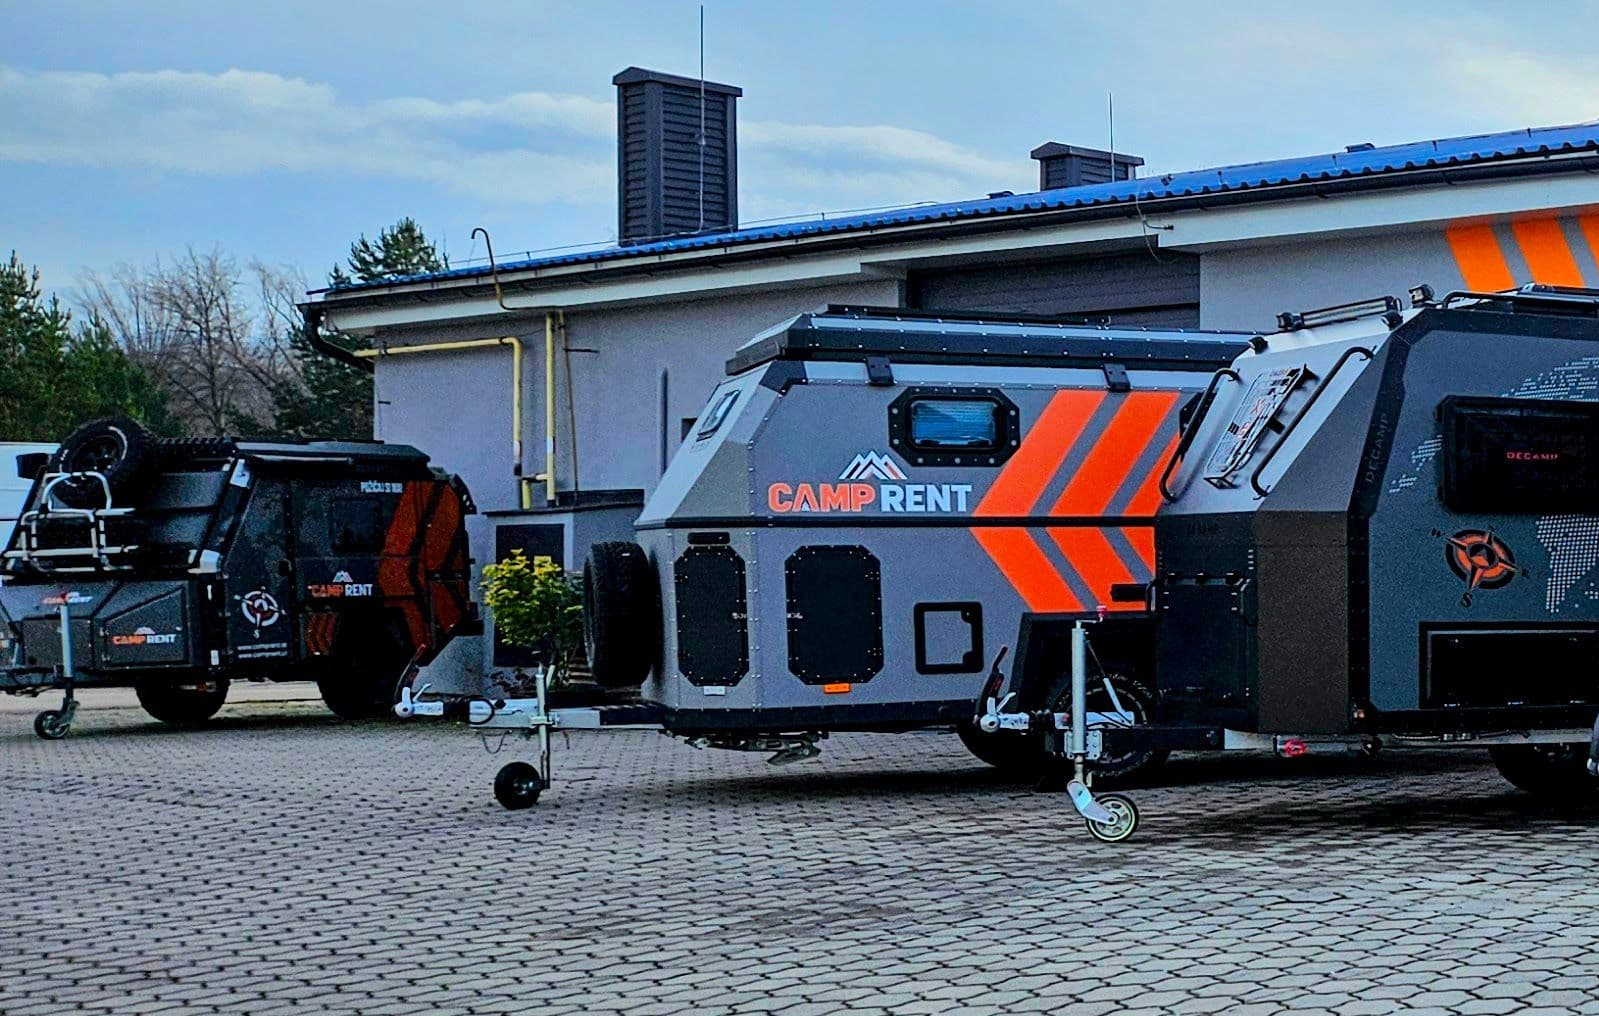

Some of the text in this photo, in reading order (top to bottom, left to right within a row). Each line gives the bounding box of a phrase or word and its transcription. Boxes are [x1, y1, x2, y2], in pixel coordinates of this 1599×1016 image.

[1506, 451, 1558, 461] DECAMP
[767, 482, 973, 513] CAMP RENT
[311, 583, 373, 597] CAMP RENT
